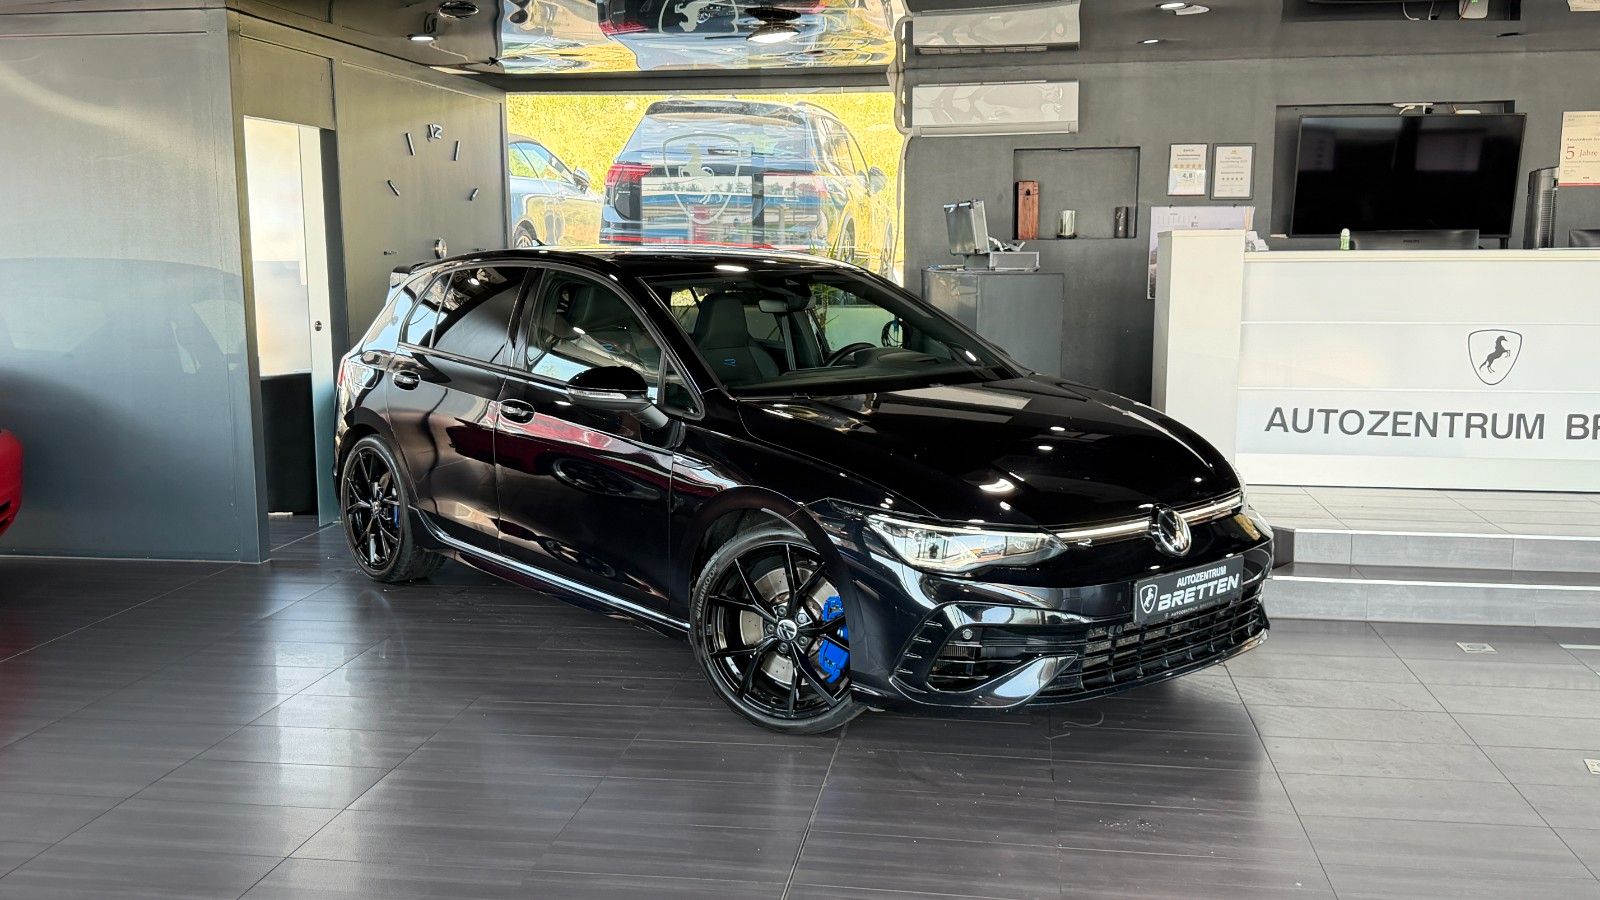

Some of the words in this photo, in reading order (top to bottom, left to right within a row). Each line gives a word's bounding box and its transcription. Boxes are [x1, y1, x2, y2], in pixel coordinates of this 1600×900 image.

[428, 123, 442, 139] 12
[1566, 146, 1575, 160] 5
[1579, 148, 1598, 158] Jahre
[1264, 406, 1545, 440] AUTOZENTRUM
[1176, 565, 1227, 588] AUTOZENTRUM
[1157, 573, 1240, 611] BRETTEN
